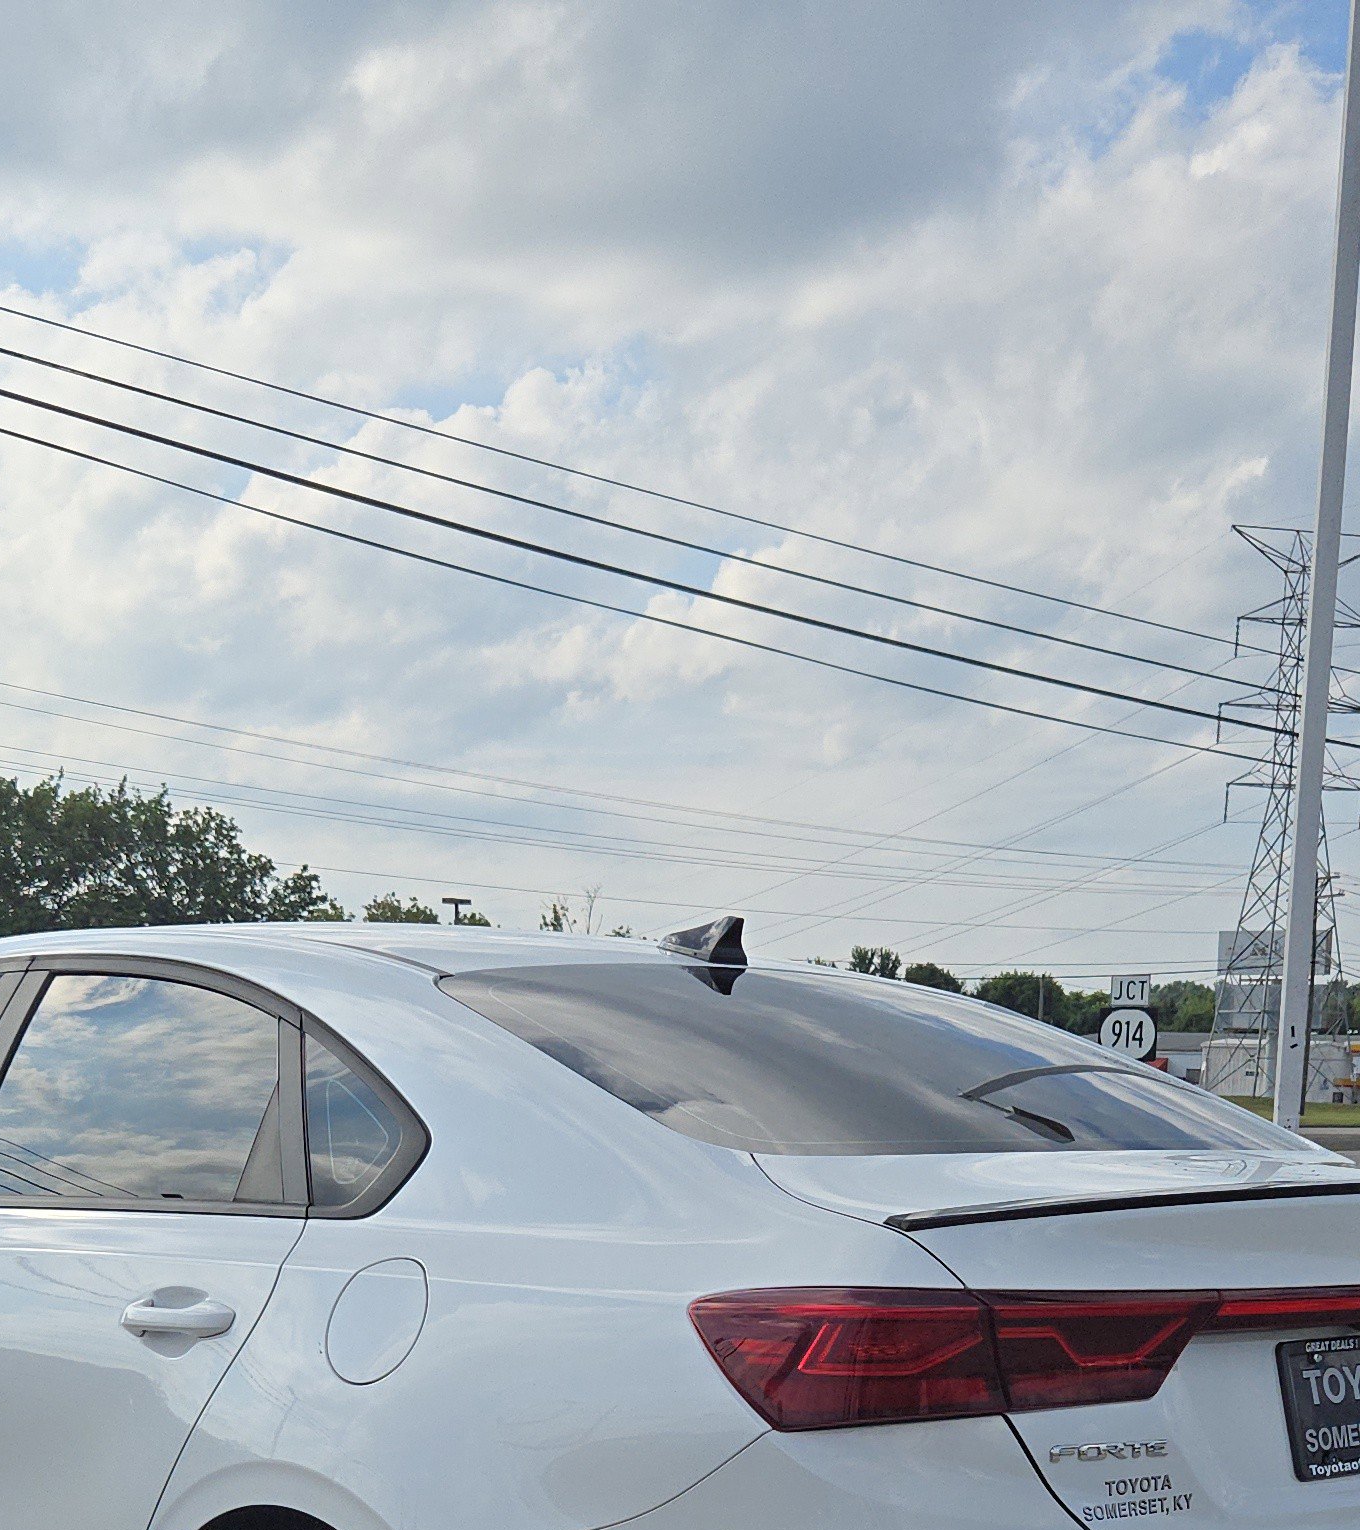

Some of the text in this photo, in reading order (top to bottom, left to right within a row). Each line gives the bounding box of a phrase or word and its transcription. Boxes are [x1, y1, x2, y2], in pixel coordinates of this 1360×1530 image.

[1113, 980, 1147, 1000] JCT
[1112, 1020, 1144, 1049] 914
[1305, 1340, 1330, 1353] GREAT
[1049, 1438, 1169, 1464] FORTE
[1105, 1474, 1172, 1497] TOYOTA
[1082, 1493, 1193, 1522] SOMERSET, KY
